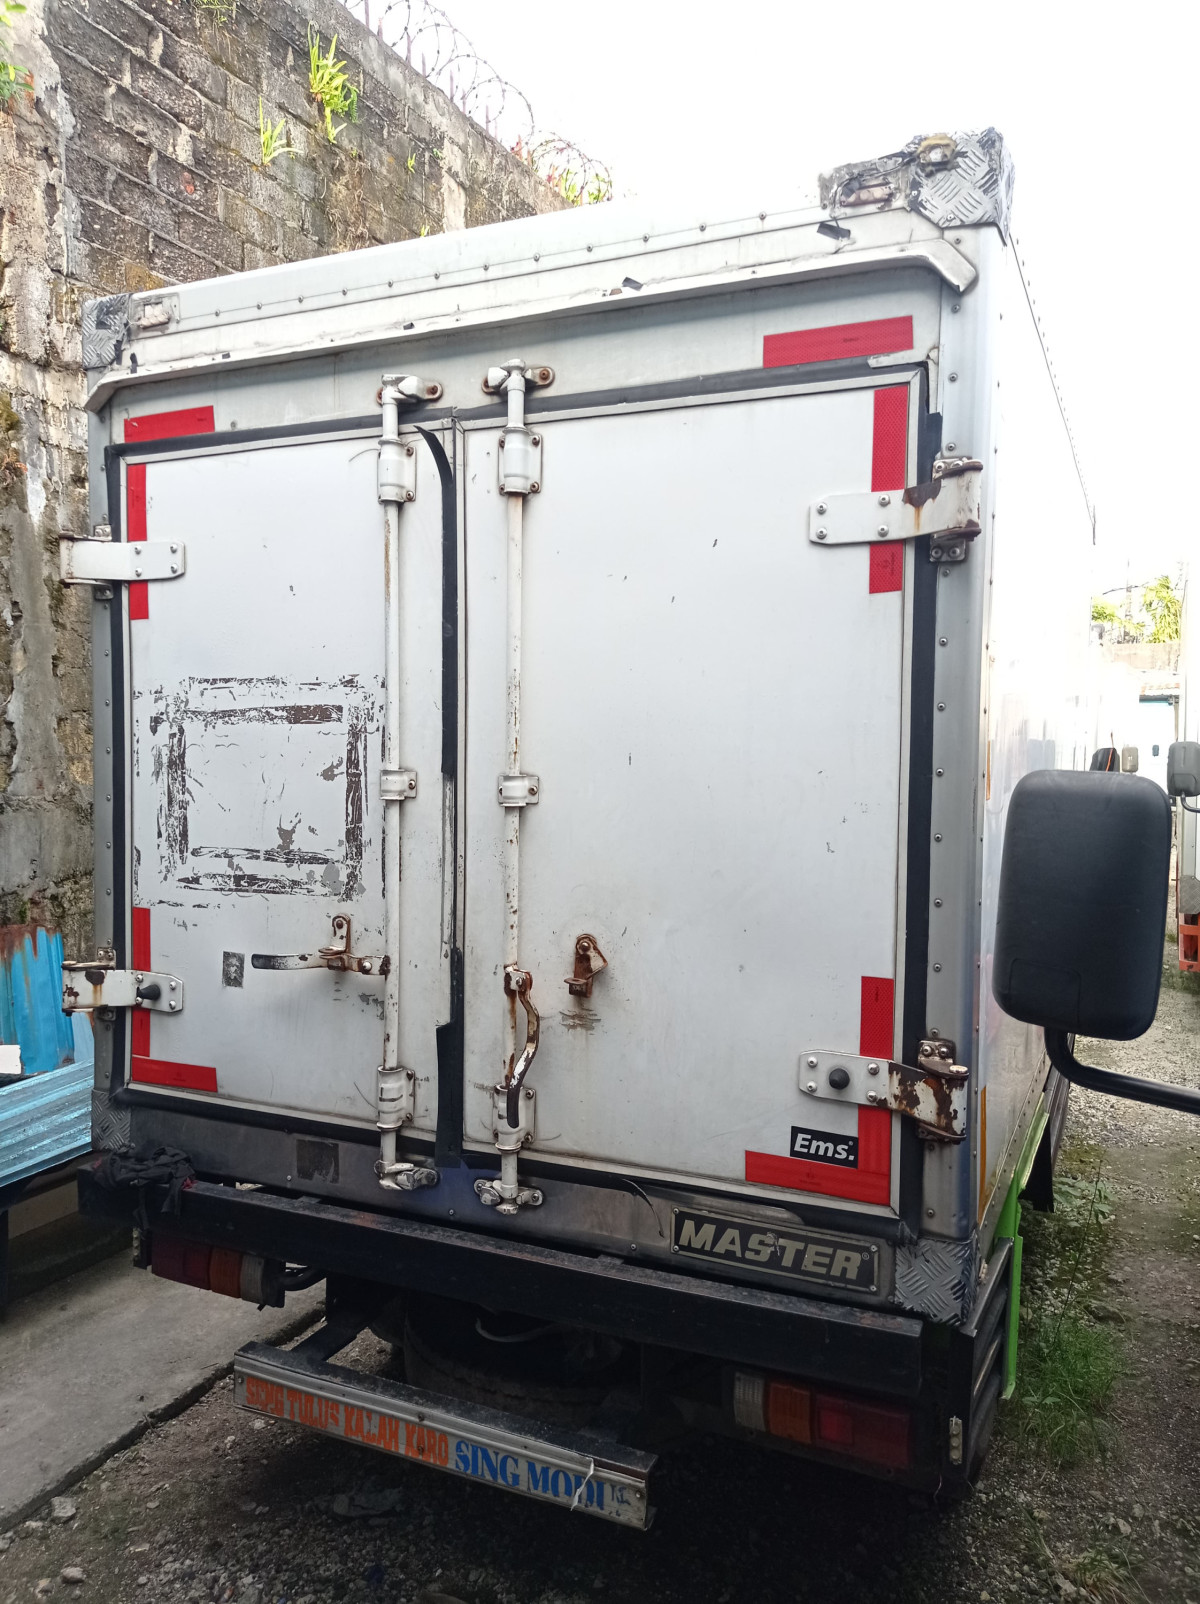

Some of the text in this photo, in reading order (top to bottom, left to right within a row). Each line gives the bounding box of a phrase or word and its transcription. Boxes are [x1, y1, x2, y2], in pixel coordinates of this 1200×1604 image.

[678, 1219, 862, 1280] MASTER
[287, 1389, 340, 1429] TULUS
[344, 1405, 400, 1452] KALAH
[405, 1422, 449, 1466] KARO
[455, 1440, 520, 1487] SING
